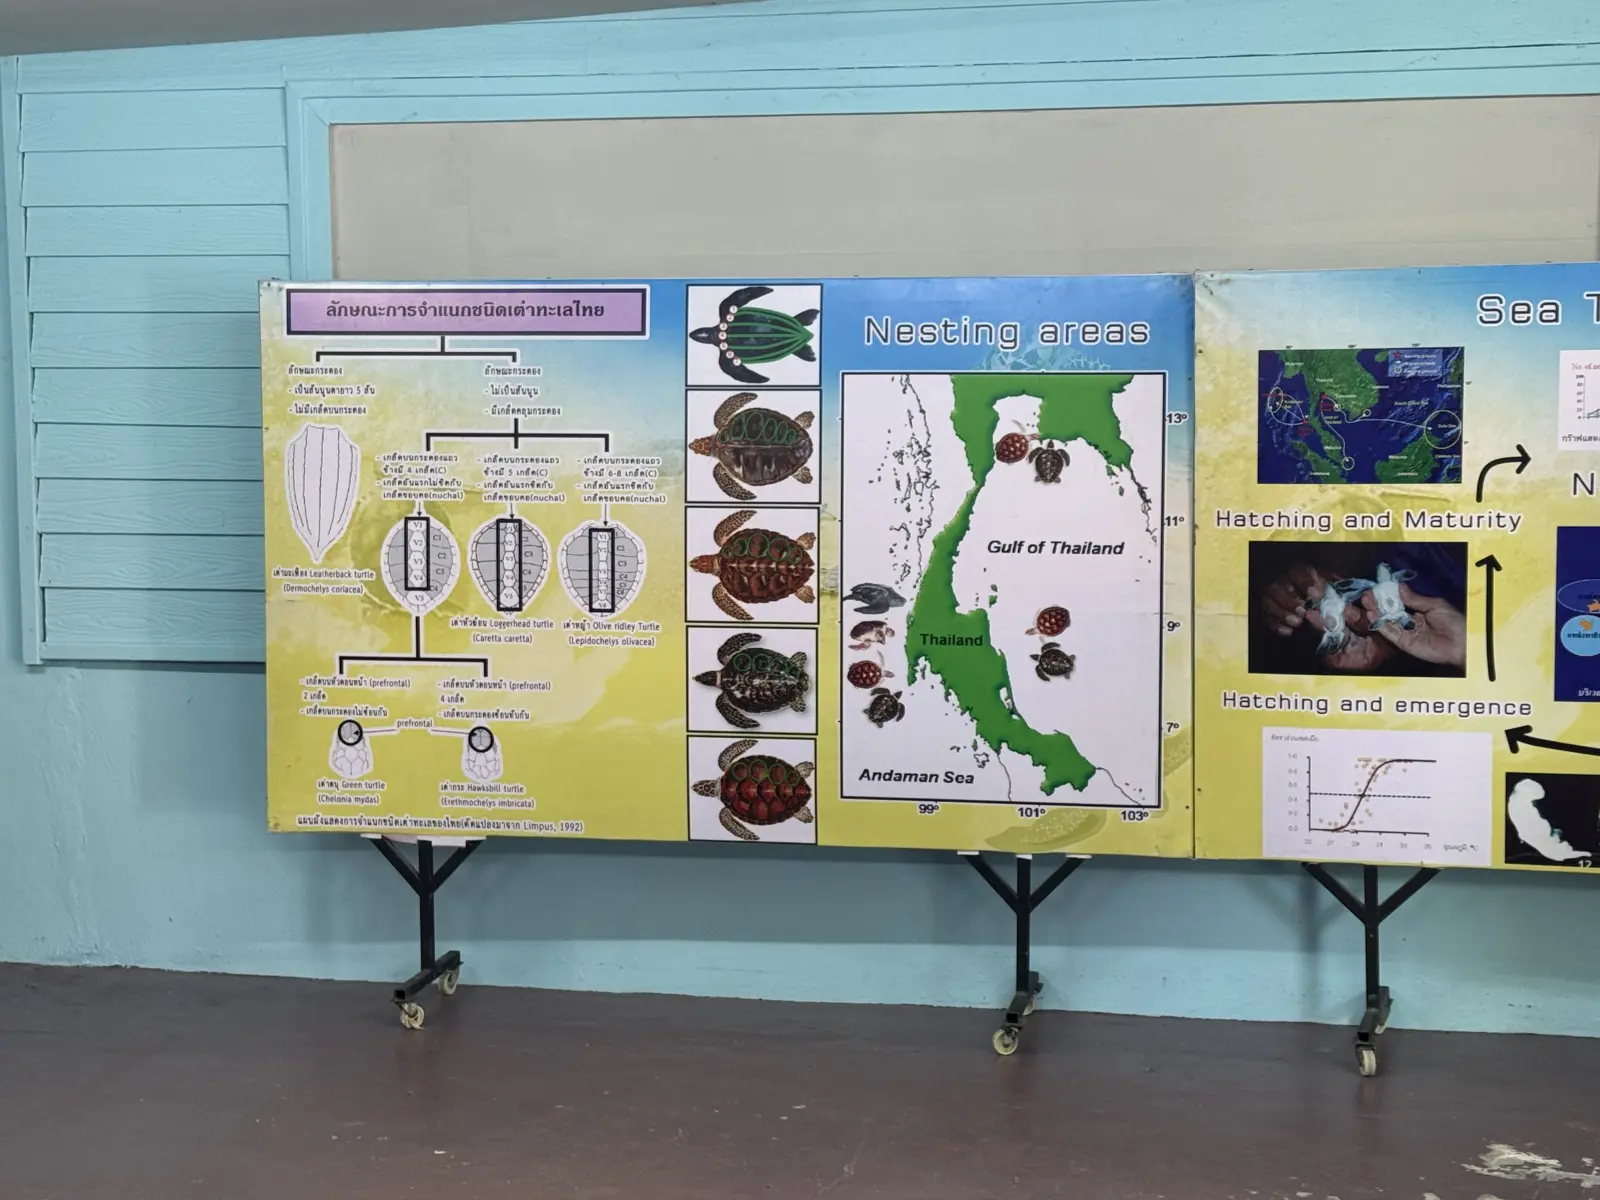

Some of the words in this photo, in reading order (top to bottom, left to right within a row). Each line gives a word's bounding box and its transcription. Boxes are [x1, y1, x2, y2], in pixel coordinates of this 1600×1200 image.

[326, 299, 605, 318] ลักษณะการจำแนกชนิดเต่าทะเลไทย
[1479, 296, 1560, 324] Sea
[865, 317, 1018, 349] Nesting
[1040, 322, 1150, 344] areas
[288, 364, 343, 375] ลักษณะกระดอง
[484, 365, 541, 375] ลักษณะกระดอง
[356, 386, 361, 394] 5
[1216, 510, 1331, 532] Hatching
[1344, 511, 1390, 528] and
[1405, 511, 1522, 532] Maturity
[987, 540, 1025, 554] Gulf
[1027, 541, 1045, 554] of
[1051, 541, 1125, 556] Thailand
[309, 569, 352, 579] Leatherback
[354, 571, 375, 579] turtle
[284, 584, 329, 594] (Dermochelys
[331, 585, 364, 594] coriacea)
[489, 619, 530, 629] Loggerhead
[533, 620, 554, 628] turtle
[593, 621, 612, 630] Olive
[614, 622, 636, 632] ridley
[638, 622, 660, 631] Turtle
[473, 633, 501, 643] (Caretta
[504, 634, 533, 643] caretta)
[568, 636, 619, 646] (Lepidochelys
[621, 636, 655, 646] olivacea)
[920, 633, 983, 646] Thailand
[369, 679, 411, 689] (prefrontal)
[509, 681, 551, 691] (prefrontal)
[303, 692, 309, 700] 2
[440, 695, 445, 703] 4
[1223, 692, 1329, 714] Hatching
[1341, 697, 1382, 713] and
[1396, 699, 1532, 717] emergence
[397, 719, 433, 729] prefrontal
[859, 769, 939, 783] Andaman
[943, 771, 974, 784] Sea
[342, 781, 363, 789] Green
[365, 781, 385, 789] turtle
[467, 783, 501, 792] Hawksbill
[504, 784, 524, 793] turtle
[318, 794, 352, 803] (Chelonia
[354, 795, 379, 804] mydas)
[498, 799, 535, 809] imbricata)
[524, 820, 557, 833] Limpus,
[560, 822, 583, 832] 1992)
